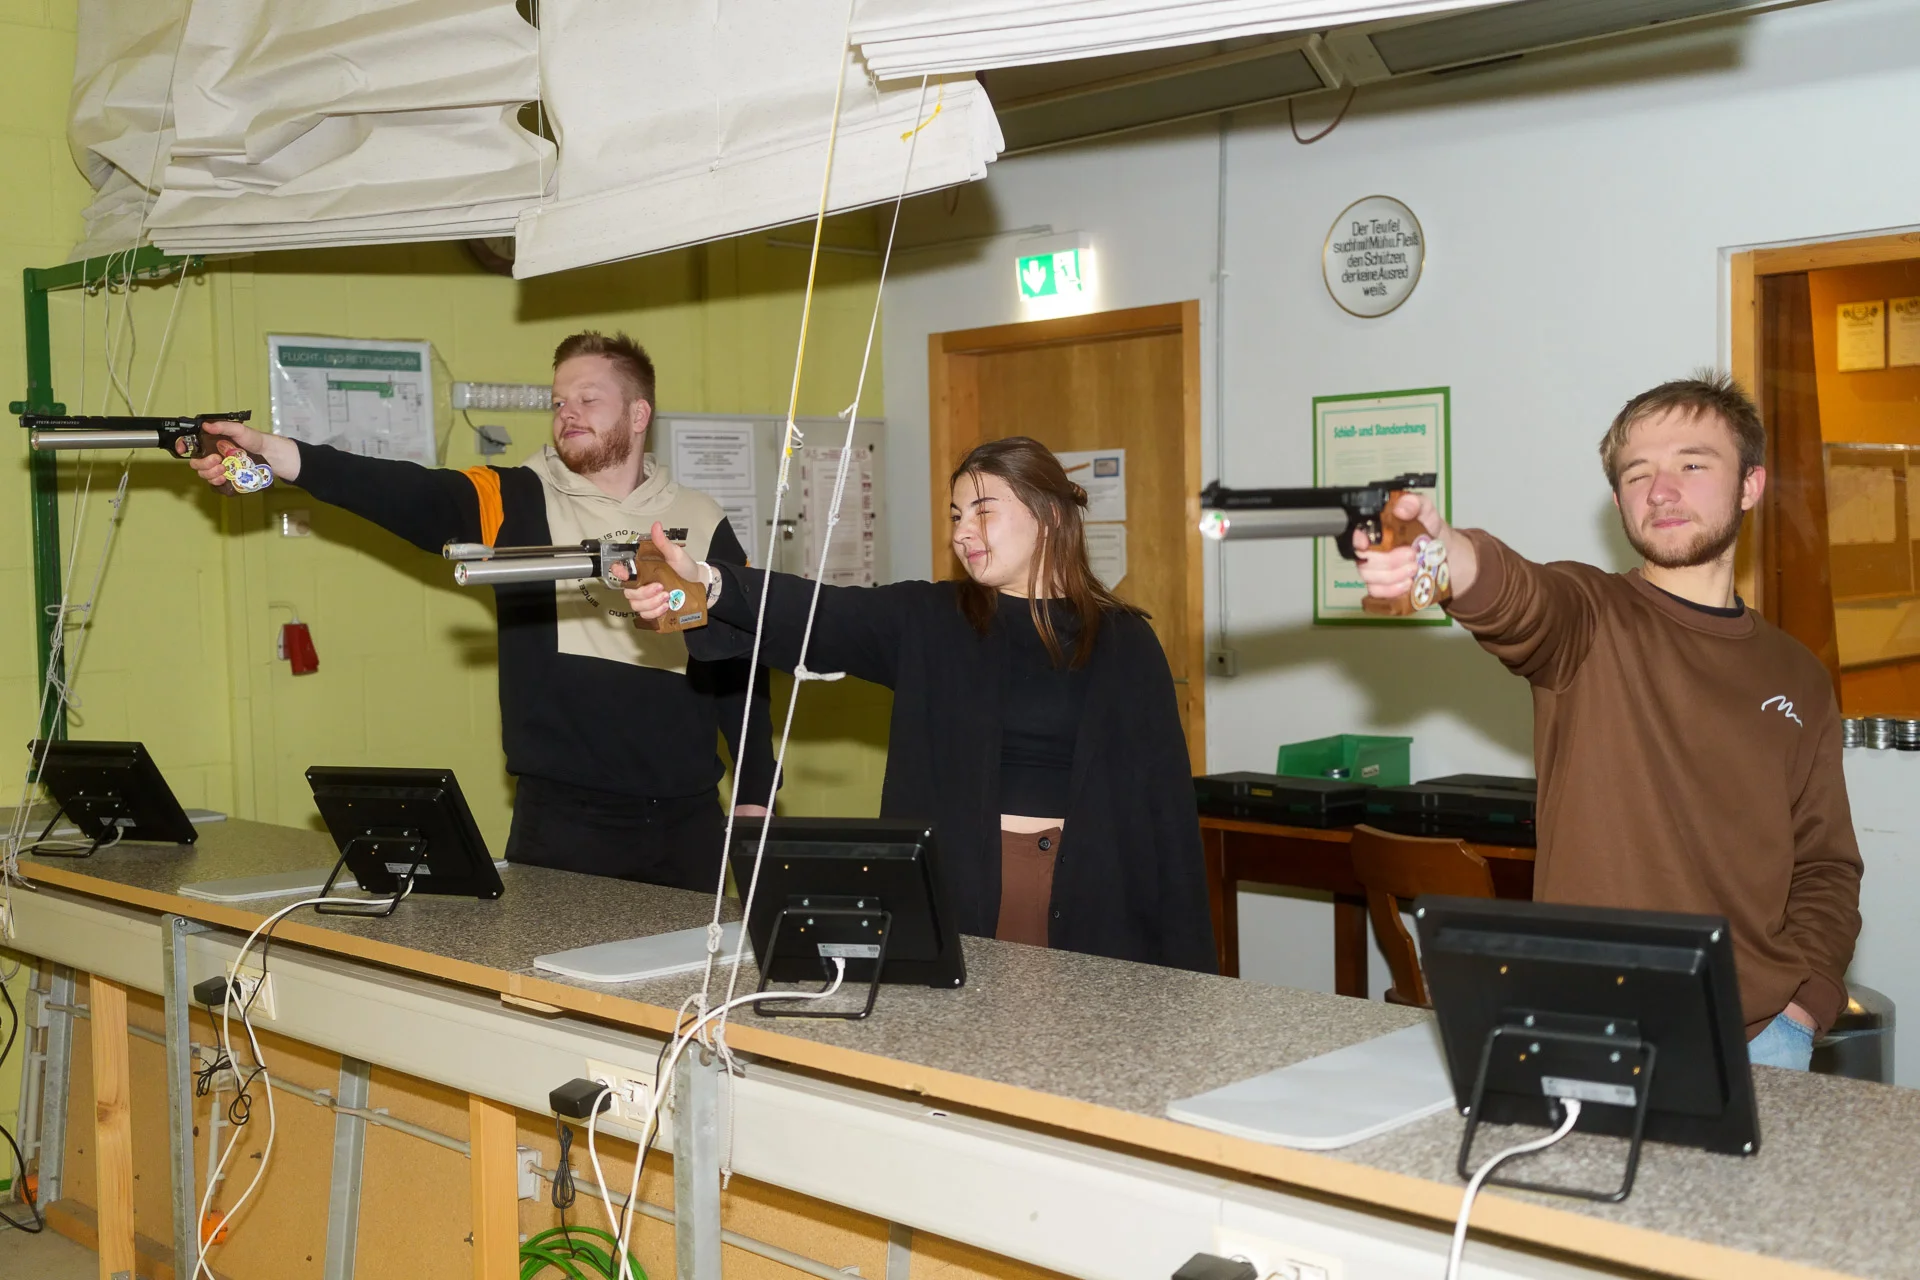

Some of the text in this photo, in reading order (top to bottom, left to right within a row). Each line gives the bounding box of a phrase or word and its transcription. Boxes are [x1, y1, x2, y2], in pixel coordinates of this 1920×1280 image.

[1351, 218, 1400, 236] Der Teufel
[1347, 250, 1406, 267] den Schützen
[1341, 268, 1355, 283] der
[1359, 424, 1373, 436] und
[603, 532, 613, 541] IS
[615, 529, 629, 537] NO
[578, 584, 600, 608] SINCE
